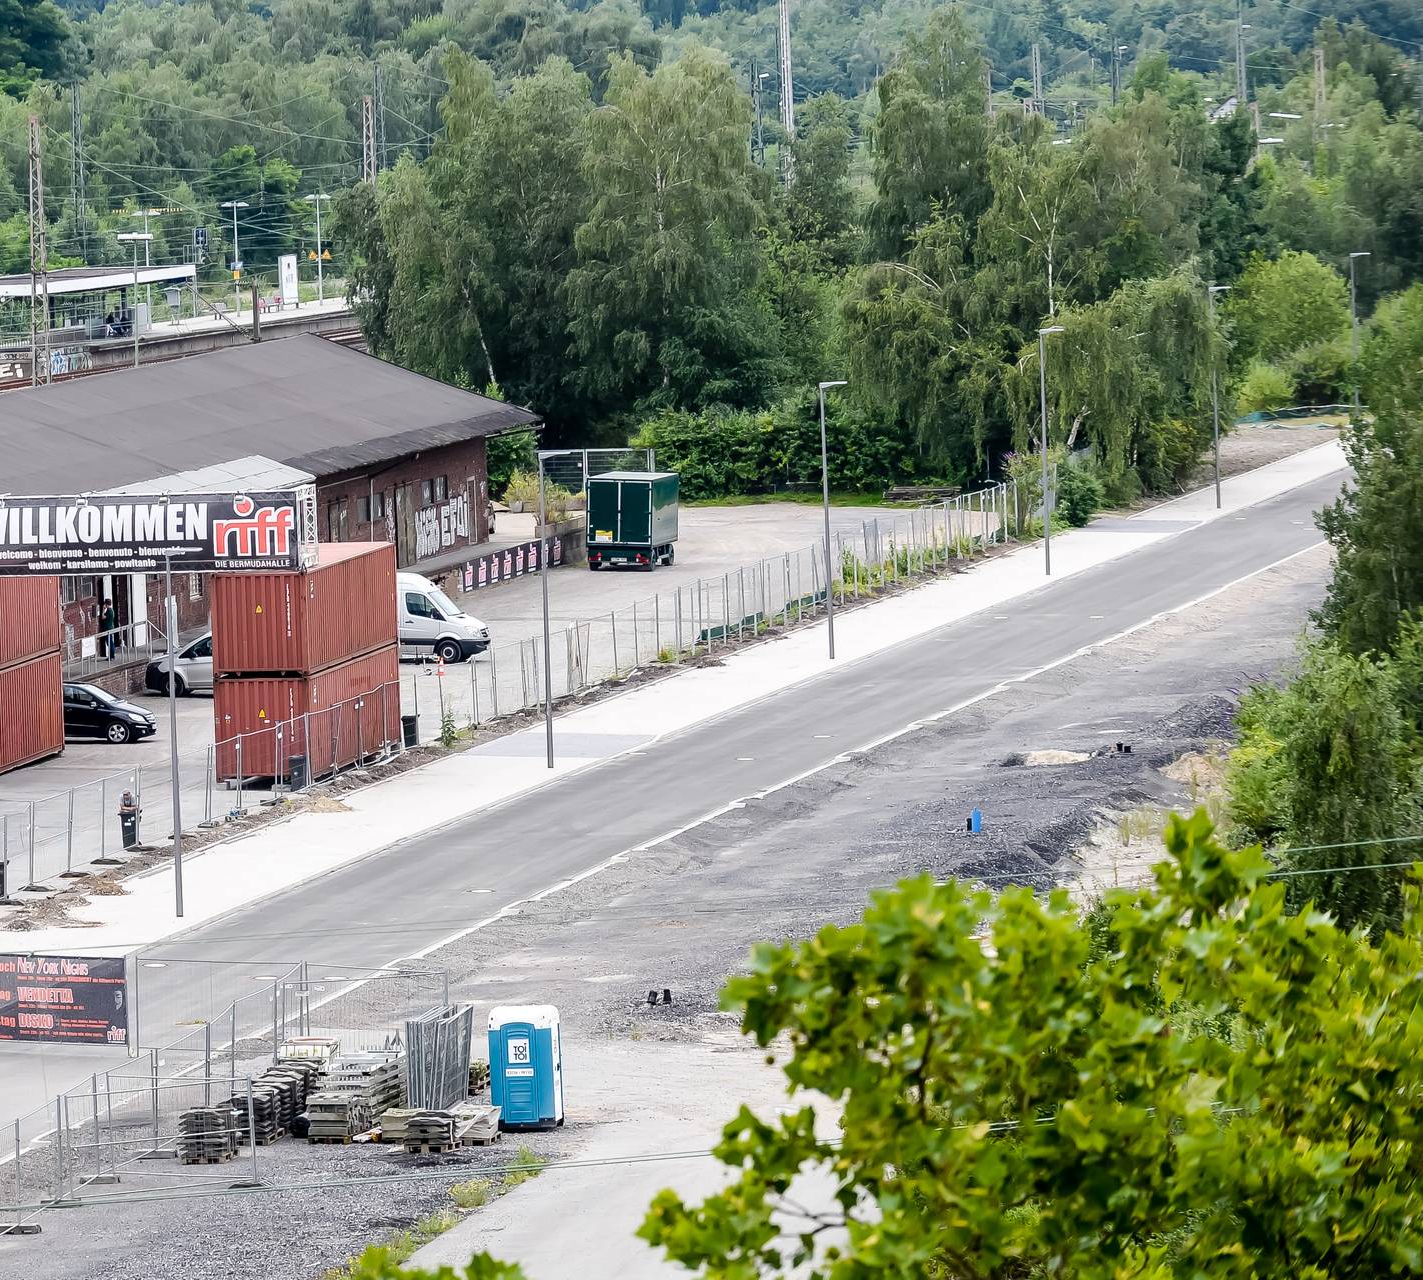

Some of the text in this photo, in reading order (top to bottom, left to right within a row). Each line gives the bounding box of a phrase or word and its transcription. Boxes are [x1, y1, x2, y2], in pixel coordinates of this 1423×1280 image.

[213, 496, 294, 557] riff
[39, 548, 83, 559] bienvenue
[89, 547, 133, 557] benvenuto
[28, 561, 61, 570] welkom
[67, 559, 109, 569] karsilama
[115, 558, 157, 569] powitanie
[215, 559, 290, 568] DIE BERMUDAHALLE
[17, 986, 74, 1003] VENDETTA
